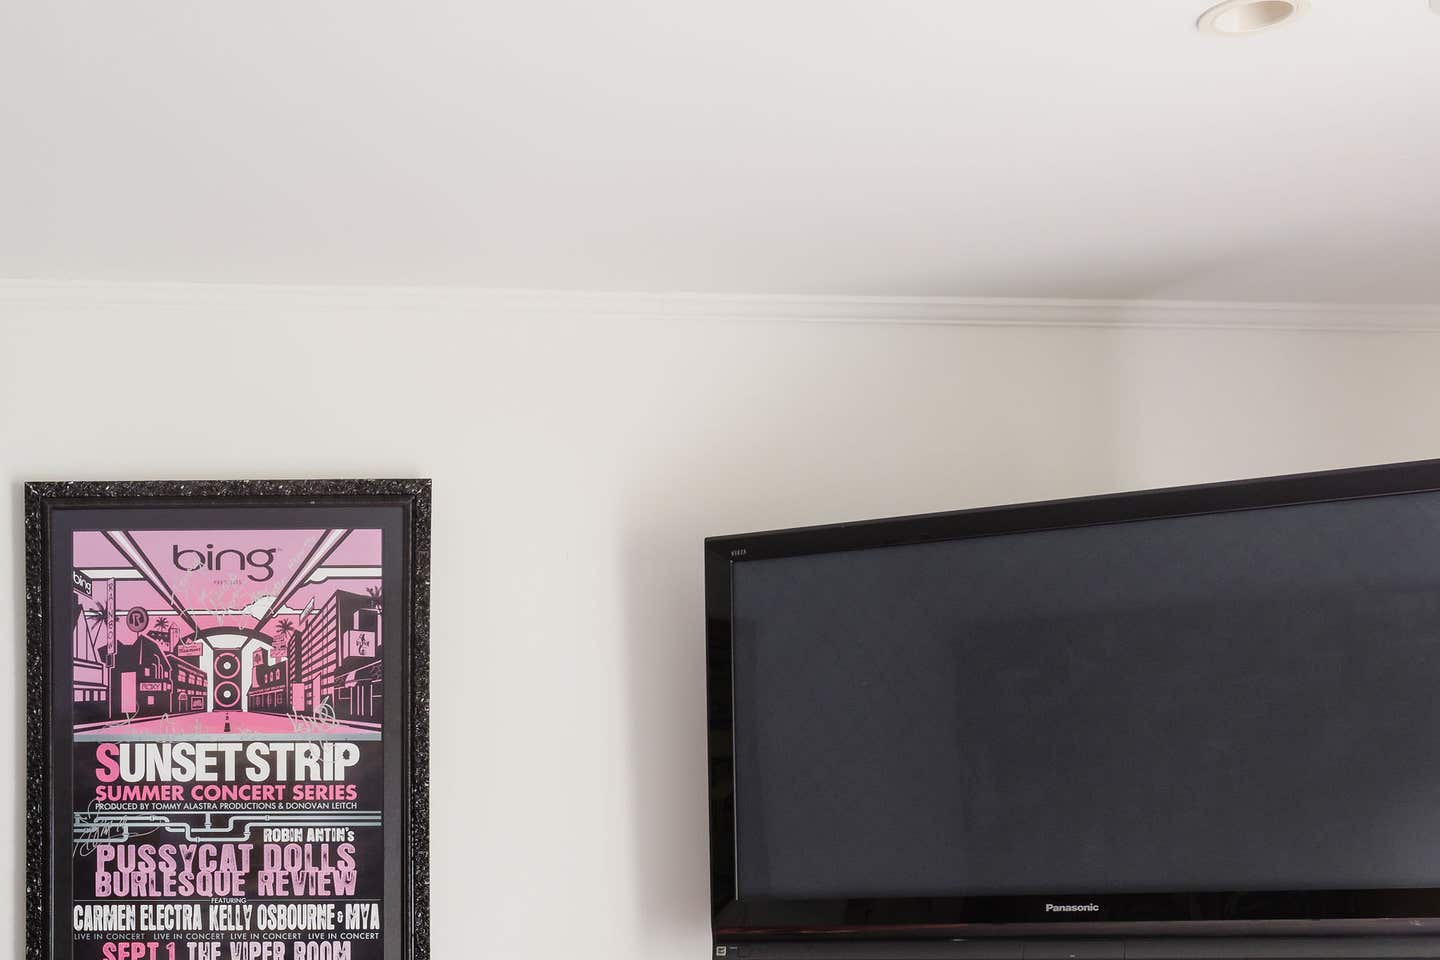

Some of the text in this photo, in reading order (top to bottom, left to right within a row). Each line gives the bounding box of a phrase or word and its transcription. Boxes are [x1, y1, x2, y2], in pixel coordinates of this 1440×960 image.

[172, 543, 277, 582] bing
[73, 571, 92, 595] bing
[95, 742, 360, 782] SUNSET STRIP
[95, 784, 357, 801] SUMMER CONCERT SERIES
[220, 802, 276, 810] PRODUCTIONS
[278, 802, 284, 810] &
[285, 802, 329, 810] DONOVAN
[331, 802, 357, 810] LEITCH
[263, 828, 303, 842] ROBIN
[96, 843, 356, 873] PUSSYCAT DOLLS
[95, 870, 357, 898] BURLESQUE REVIEW
[73, 903, 380, 931] CARMEN ELECTRA KELLY OSBOURNE & MYA
[1045, 903, 1099, 912] Panasonic
